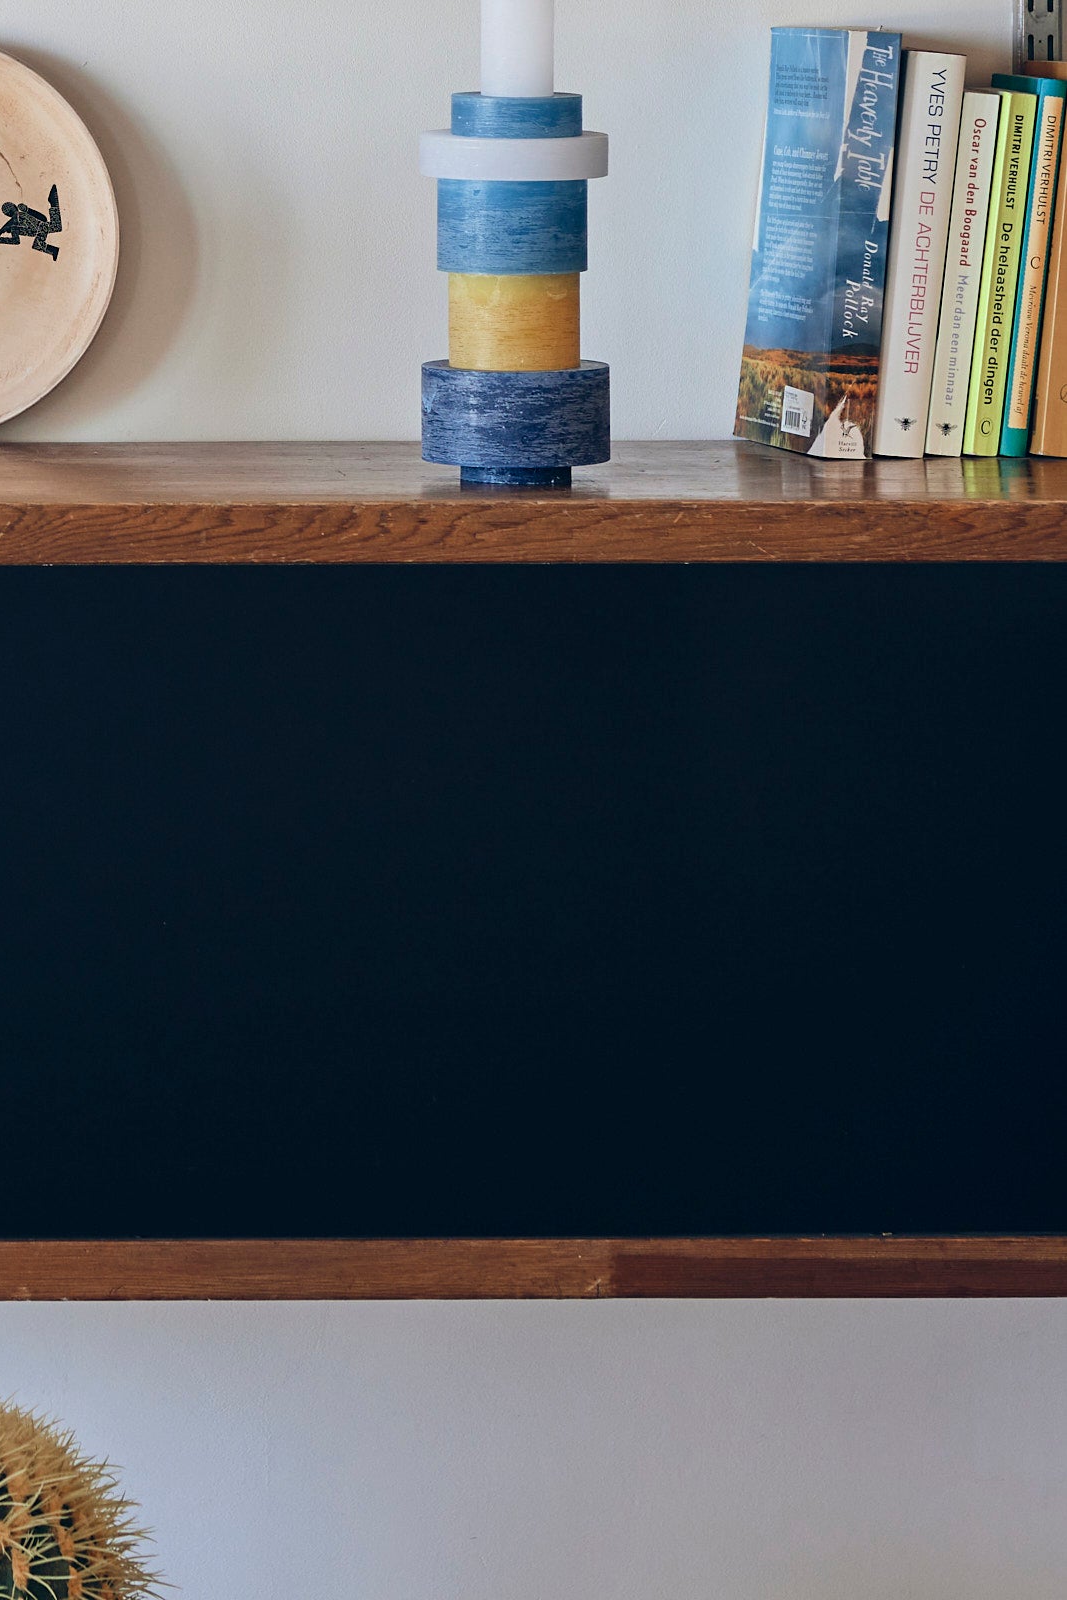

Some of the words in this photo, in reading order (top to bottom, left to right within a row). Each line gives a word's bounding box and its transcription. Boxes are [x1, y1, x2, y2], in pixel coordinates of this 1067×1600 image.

[928, 69, 947, 117] YVES
[922, 124, 942, 185] PETRY
[1012, 114, 1024, 155] DIMITRI
[1044, 115, 1057, 161] DIMITRI
[918, 191, 935, 216] DE
[1005, 158, 1020, 210] VERHULST
[1036, 164, 1051, 225] VERHULST
[1001, 223, 1013, 241] De
[862, 240, 879, 290] Donald
[992, 246, 1011, 325] helaasheid
[842, 279, 861, 339] Pollock
[856, 295, 875, 324] Ray
[904, 222, 932, 374] ACHTERBLIJVER
[989, 328, 1002, 348] der
[983, 356, 999, 405] dingen
